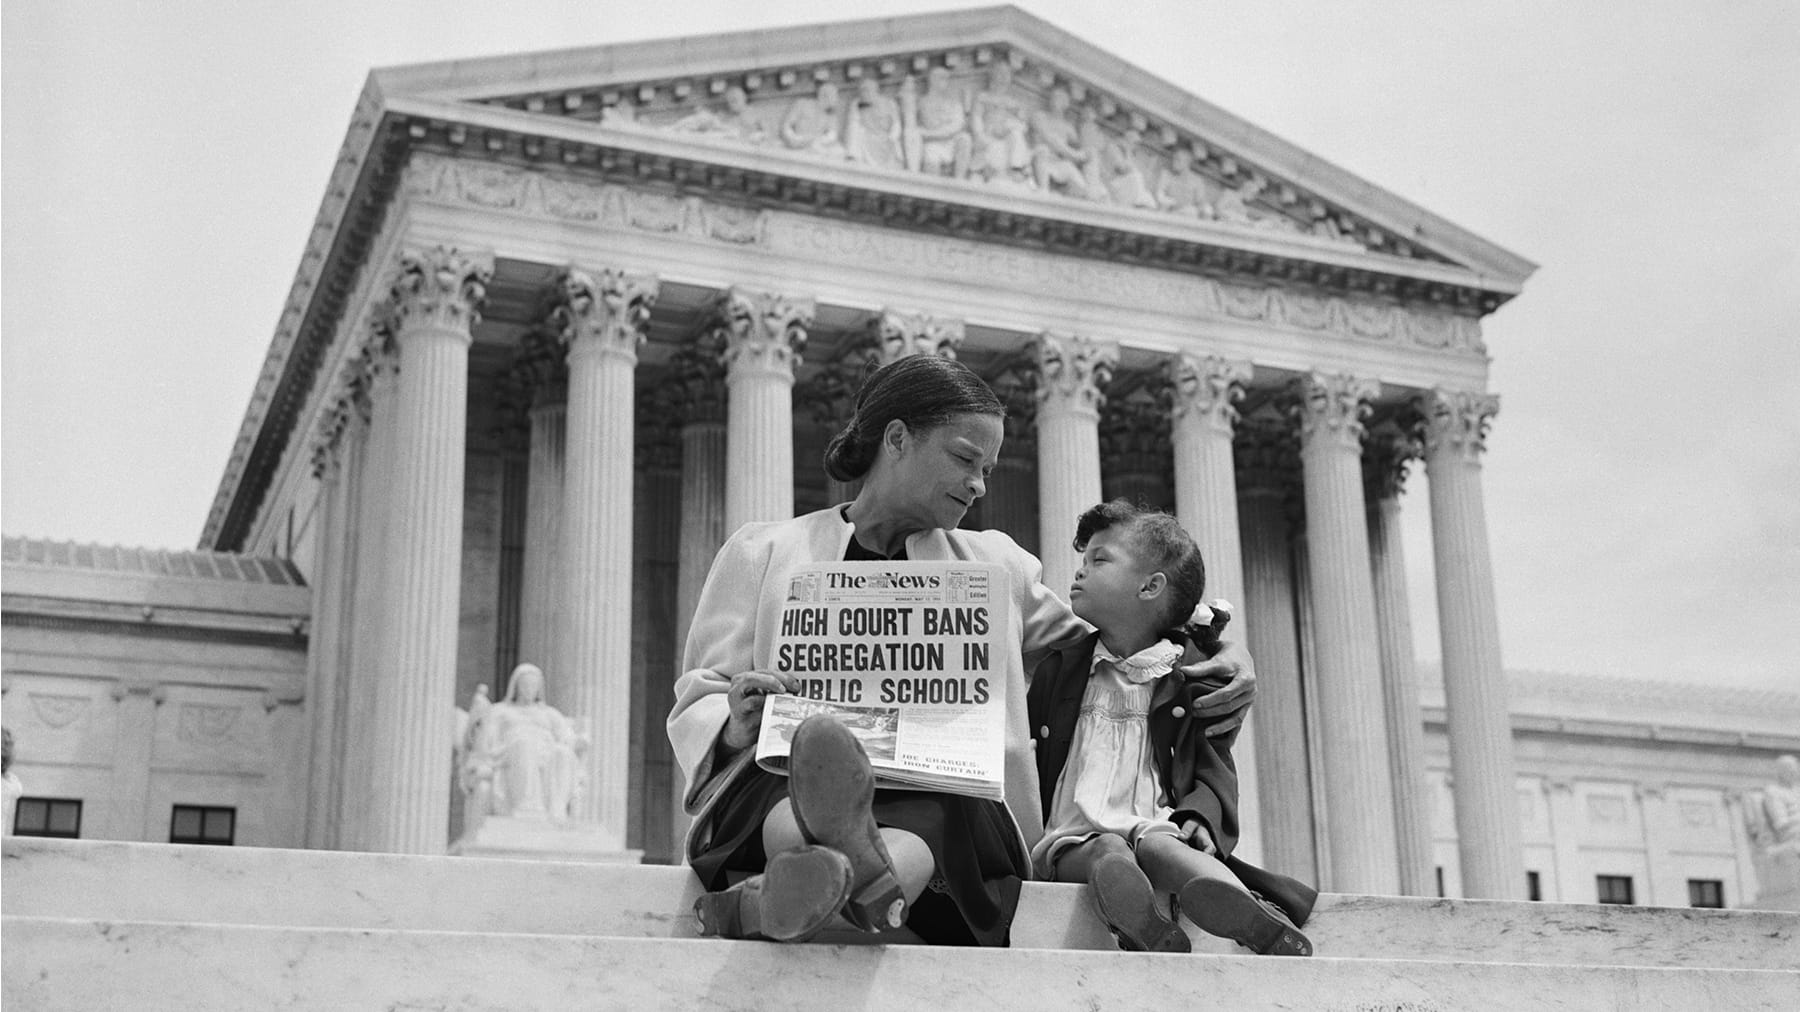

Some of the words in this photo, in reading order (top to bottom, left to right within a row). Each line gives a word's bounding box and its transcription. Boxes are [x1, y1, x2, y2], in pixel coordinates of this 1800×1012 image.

[826, 572, 866, 588] The
[885, 572, 940, 589] News
[781, 607, 828, 637] HIGH
[838, 607, 913, 637] COURT
[923, 607, 990, 636] BANS
[777, 643, 944, 672] SEGREGATION
[963, 642, 989, 671] IN
[795, 678, 863, 703] BLIC
[880, 677, 990, 704] SCHOOLS
